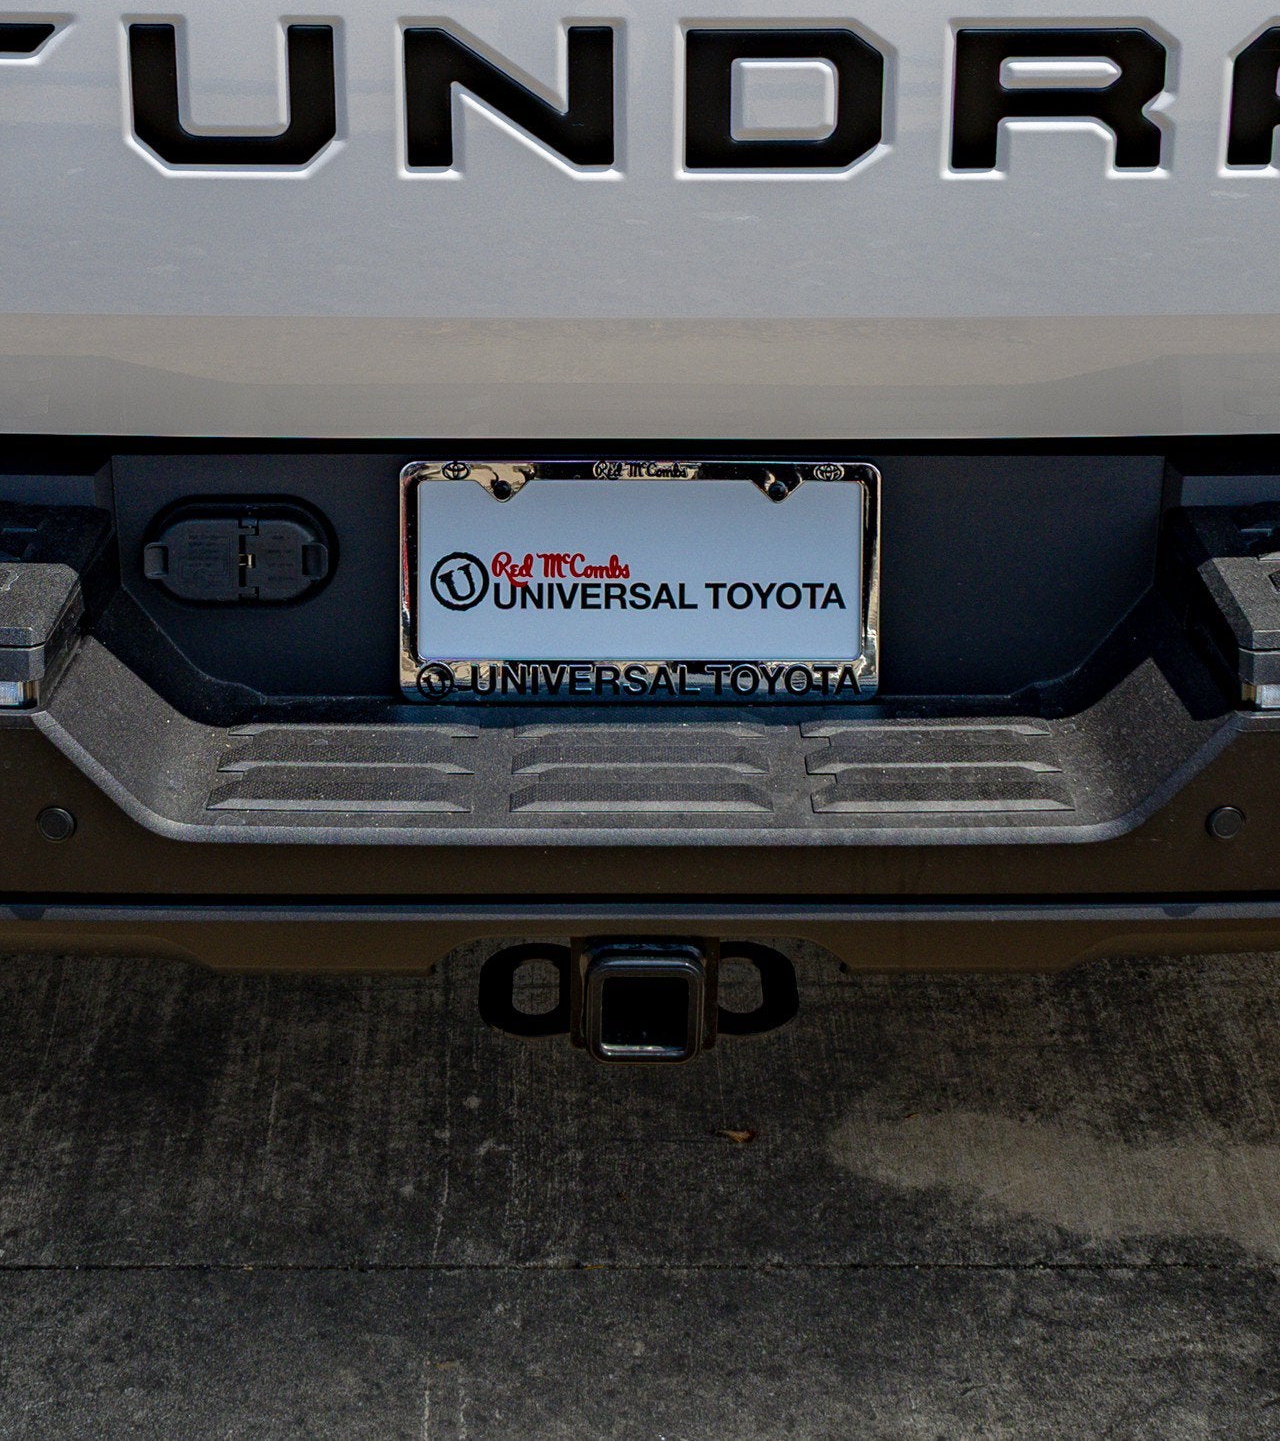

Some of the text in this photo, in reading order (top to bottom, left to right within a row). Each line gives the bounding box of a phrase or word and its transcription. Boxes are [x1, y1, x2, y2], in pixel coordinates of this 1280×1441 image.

[594, 461, 687, 479] Red McCombs
[491, 552, 630, 588] Red McCombs
[493, 582, 698, 610] UNIVERSAL
[705, 582, 847, 610] TOYOTA
[471, 663, 700, 696] UNIVERSAL
[705, 663, 863, 696] TOYOTA
